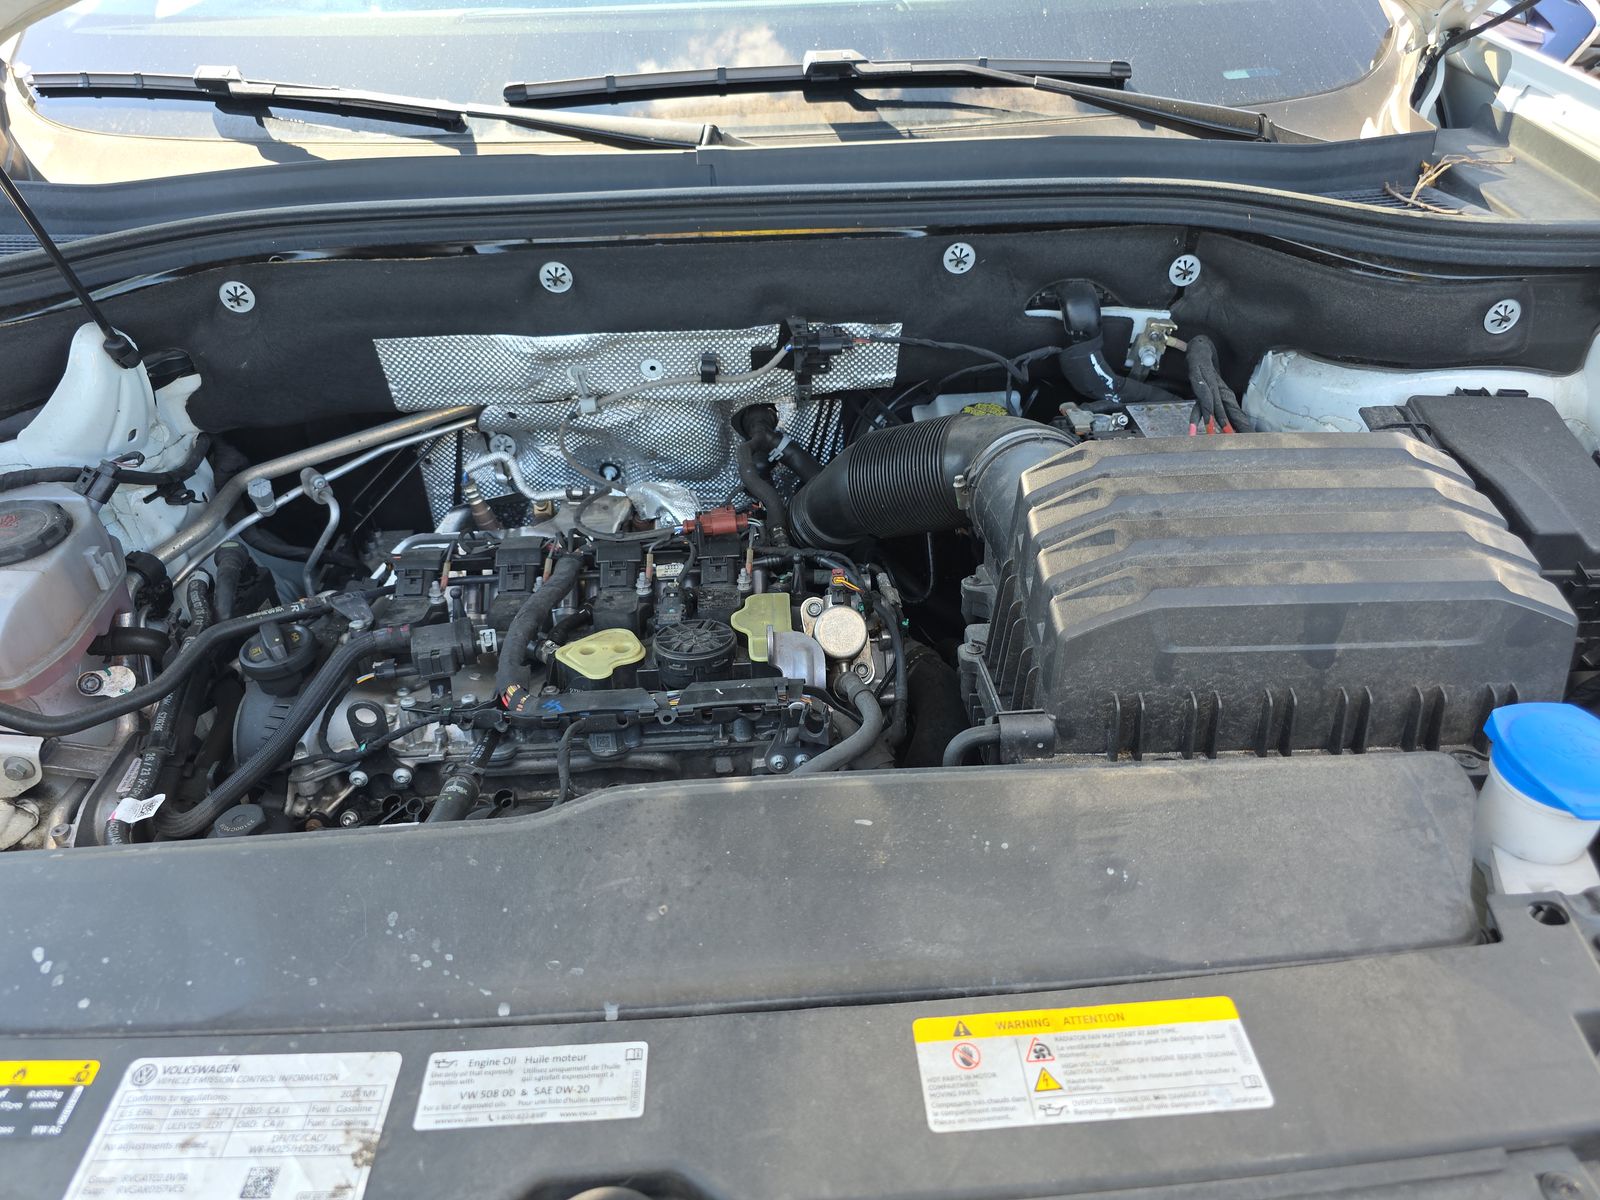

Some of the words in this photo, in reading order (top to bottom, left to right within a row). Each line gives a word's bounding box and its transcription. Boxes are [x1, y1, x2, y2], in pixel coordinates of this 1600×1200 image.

[995, 1018, 1050, 1030] WARNING
[1064, 1012, 1125, 1025] ATTENTION
[469, 1059, 500, 1068] Engine
[503, 1056, 516, 1065] Oil
[525, 1055, 552, 1064] Huile
[553, 1054, 587, 1063] moteur
[162, 1064, 241, 1075] VOLKSWAGEN
[192, 1075, 234, 1084] EMISSION
[236, 1074, 276, 1083] CONTROL
[278, 1073, 340, 1082] INFORMATION
[363, 1089, 378, 1097] MY
[460, 1090, 478, 1100] VW
[480, 1089, 500, 1099] 508
[502, 1088, 516, 1097] 00
[521, 1088, 529, 1096] &
[534, 1086, 554, 1095] SAE
[555, 1084, 590, 1094] 0W-20
[127, 1095, 167, 1103] Conforms
[268, 1106, 281, 1115] CA
[336, 1103, 373, 1113] Gasoline
[117, 1141, 174, 1152] adjustments
